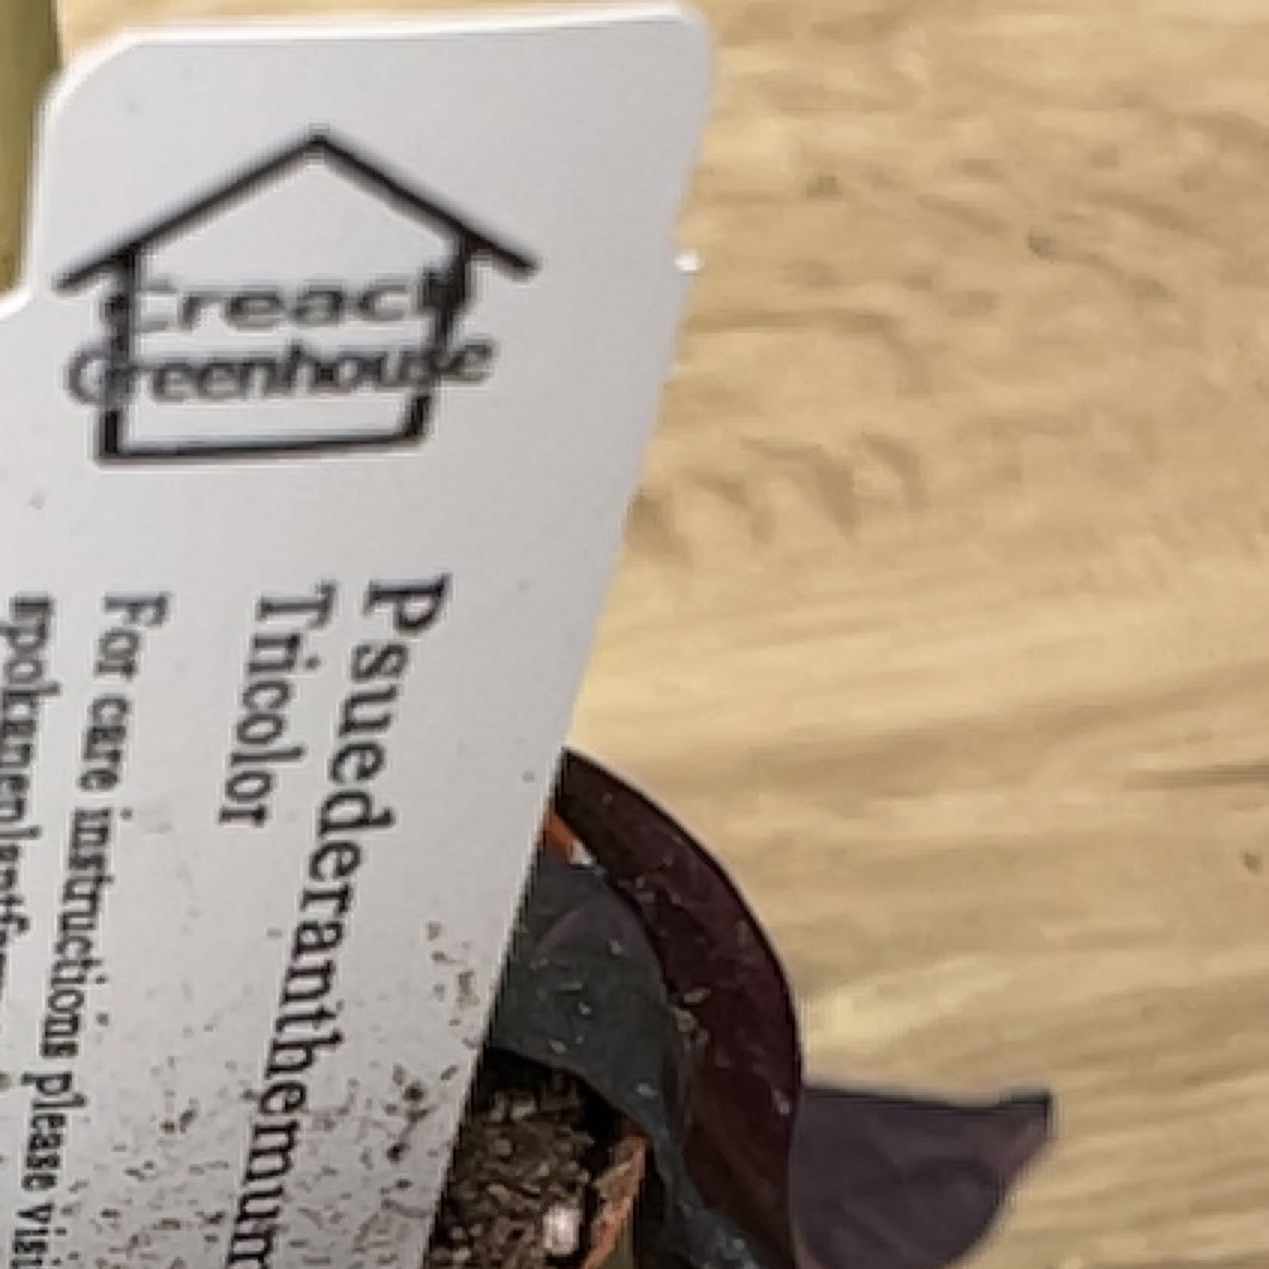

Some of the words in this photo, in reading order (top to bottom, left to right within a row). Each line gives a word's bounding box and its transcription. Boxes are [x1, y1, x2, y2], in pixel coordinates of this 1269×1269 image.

[67, 339, 495, 407] Greenhouse
[94, 592, 170, 680] For
[76, 694, 131, 792] care
[218, 579, 336, 826] Tricolor
[39, 806, 133, 1060] instructions
[20, 1071, 87, 1192] please
